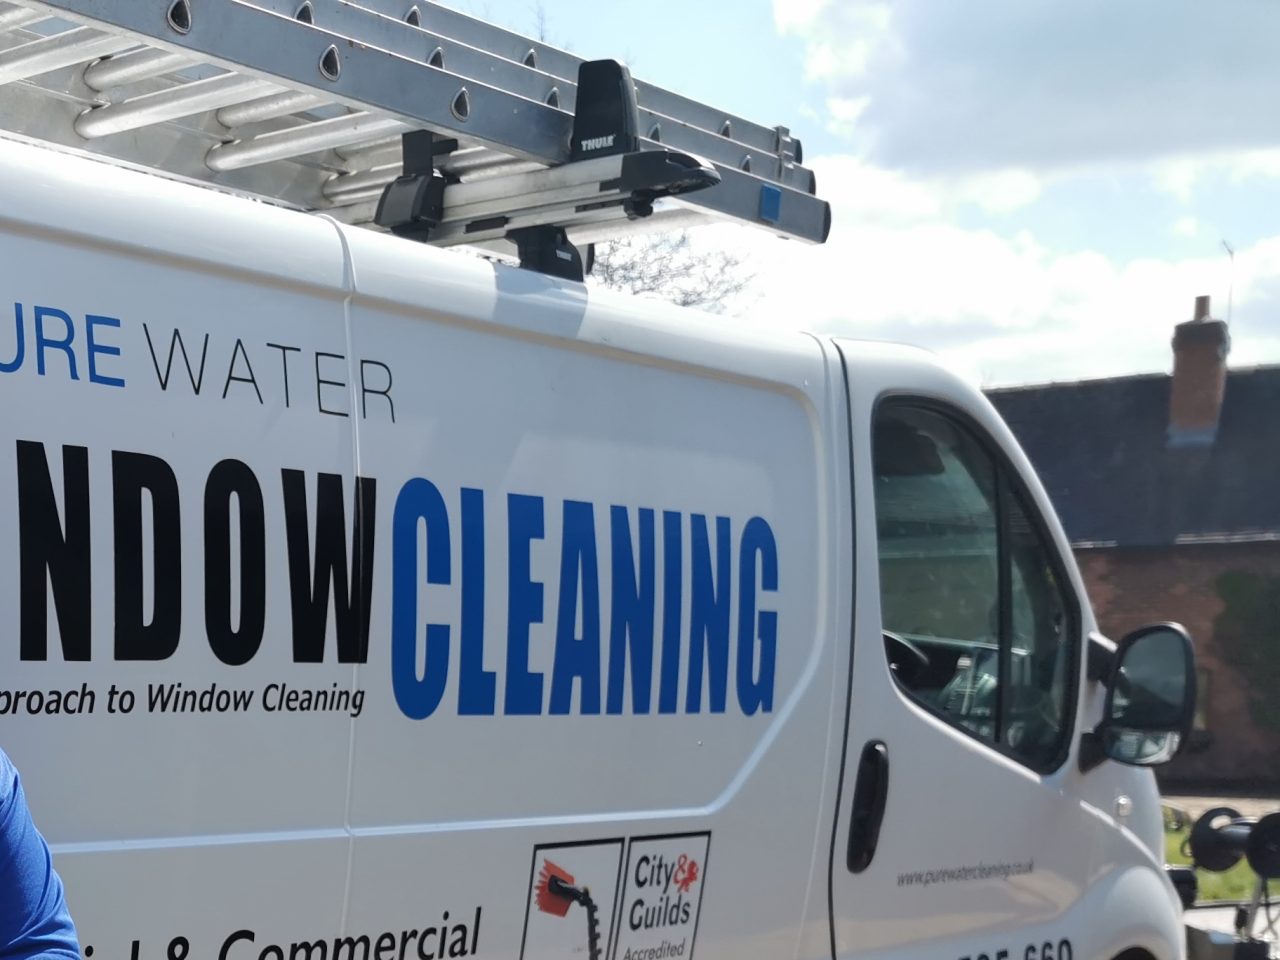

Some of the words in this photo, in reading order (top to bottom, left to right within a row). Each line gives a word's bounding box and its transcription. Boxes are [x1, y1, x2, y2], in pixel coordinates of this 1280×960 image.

[581, 135, 614, 151] THULE
[142, 322, 395, 424] WATER
[391, 477, 778, 720] CLEANING
[107, 685, 135, 714] to
[147, 682, 254, 713] Window
[262, 682, 367, 718] Cleaning
[629, 894, 690, 931] Guilds
